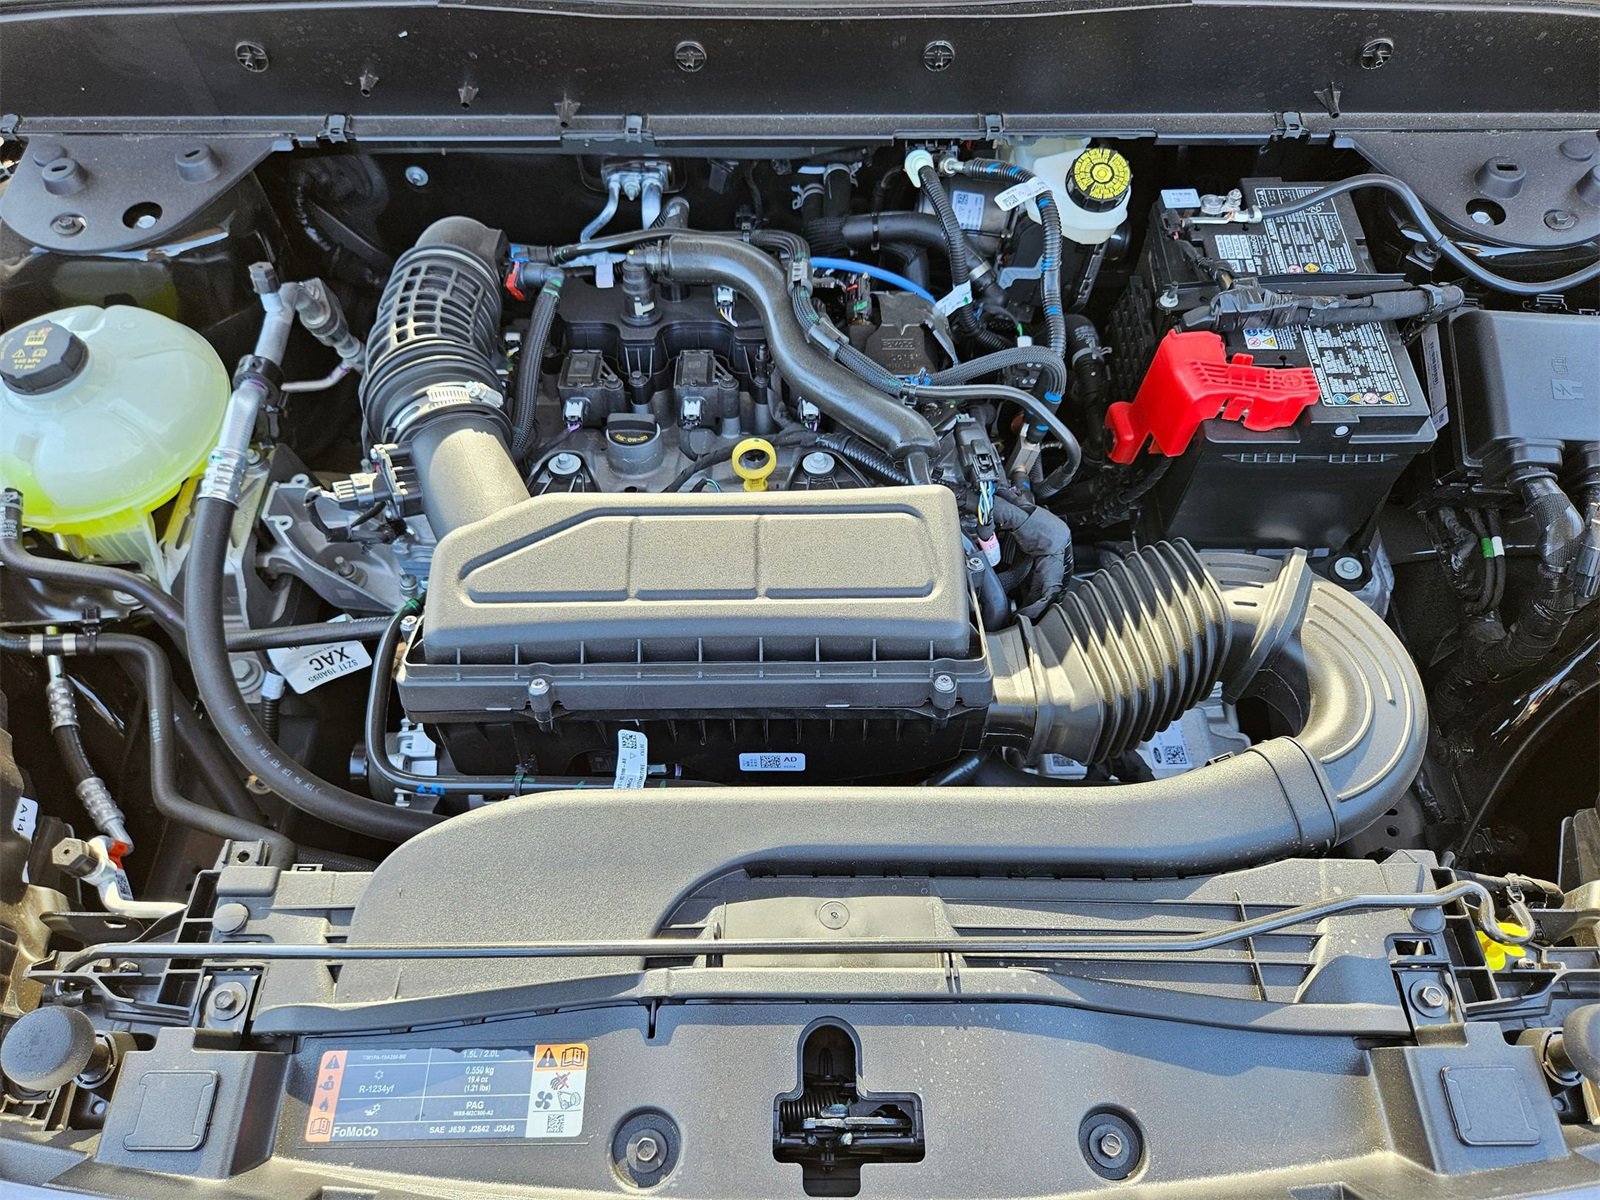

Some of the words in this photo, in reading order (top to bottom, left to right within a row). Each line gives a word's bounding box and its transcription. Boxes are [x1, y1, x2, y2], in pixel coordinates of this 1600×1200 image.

[309, 646, 351, 671] XAC
[17, 803, 28, 831] A14
[465, 1067, 484, 1075] 0.550
[485, 1066, 495, 1076] kg
[466, 1101, 484, 1109] PAG
[332, 1126, 379, 1137] FoMoCo
[429, 1126, 445, 1134] SAE
